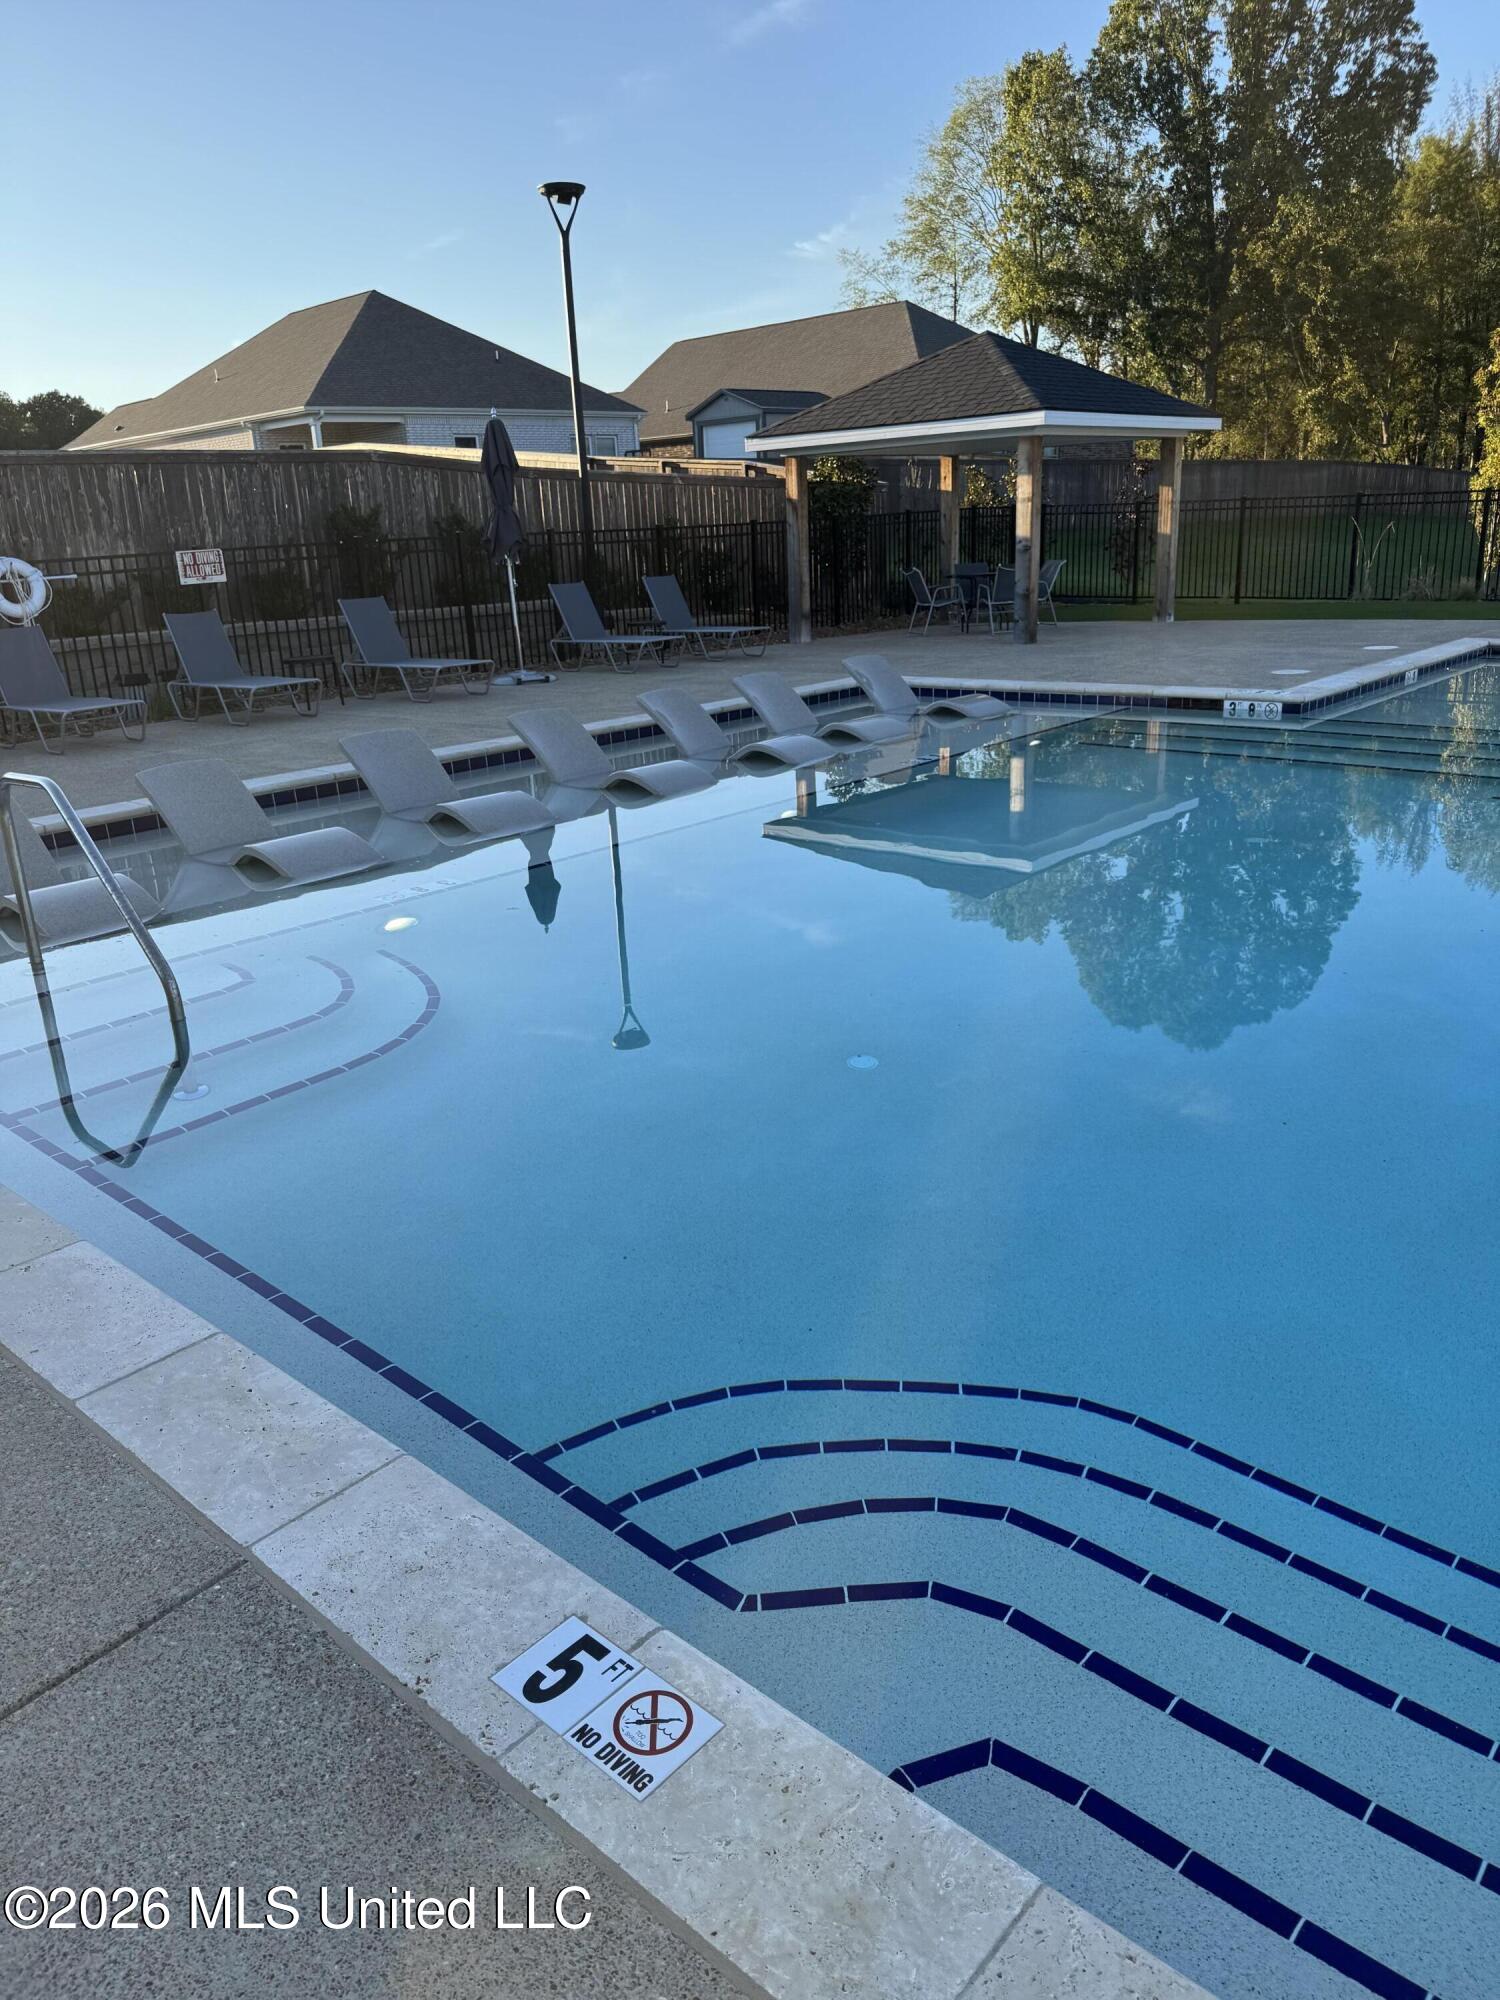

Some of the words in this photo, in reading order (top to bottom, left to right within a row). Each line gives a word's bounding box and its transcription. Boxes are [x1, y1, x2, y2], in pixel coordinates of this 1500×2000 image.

[183, 552, 193, 565] NO
[195, 550, 220, 564] DIVING
[186, 563, 221, 577] ALLOWED
[522, 1633, 611, 1704] 5
[601, 1658, 634, 1682] FT
[571, 1723, 602, 1750] NO
[594, 1742, 654, 1793] DIVING
